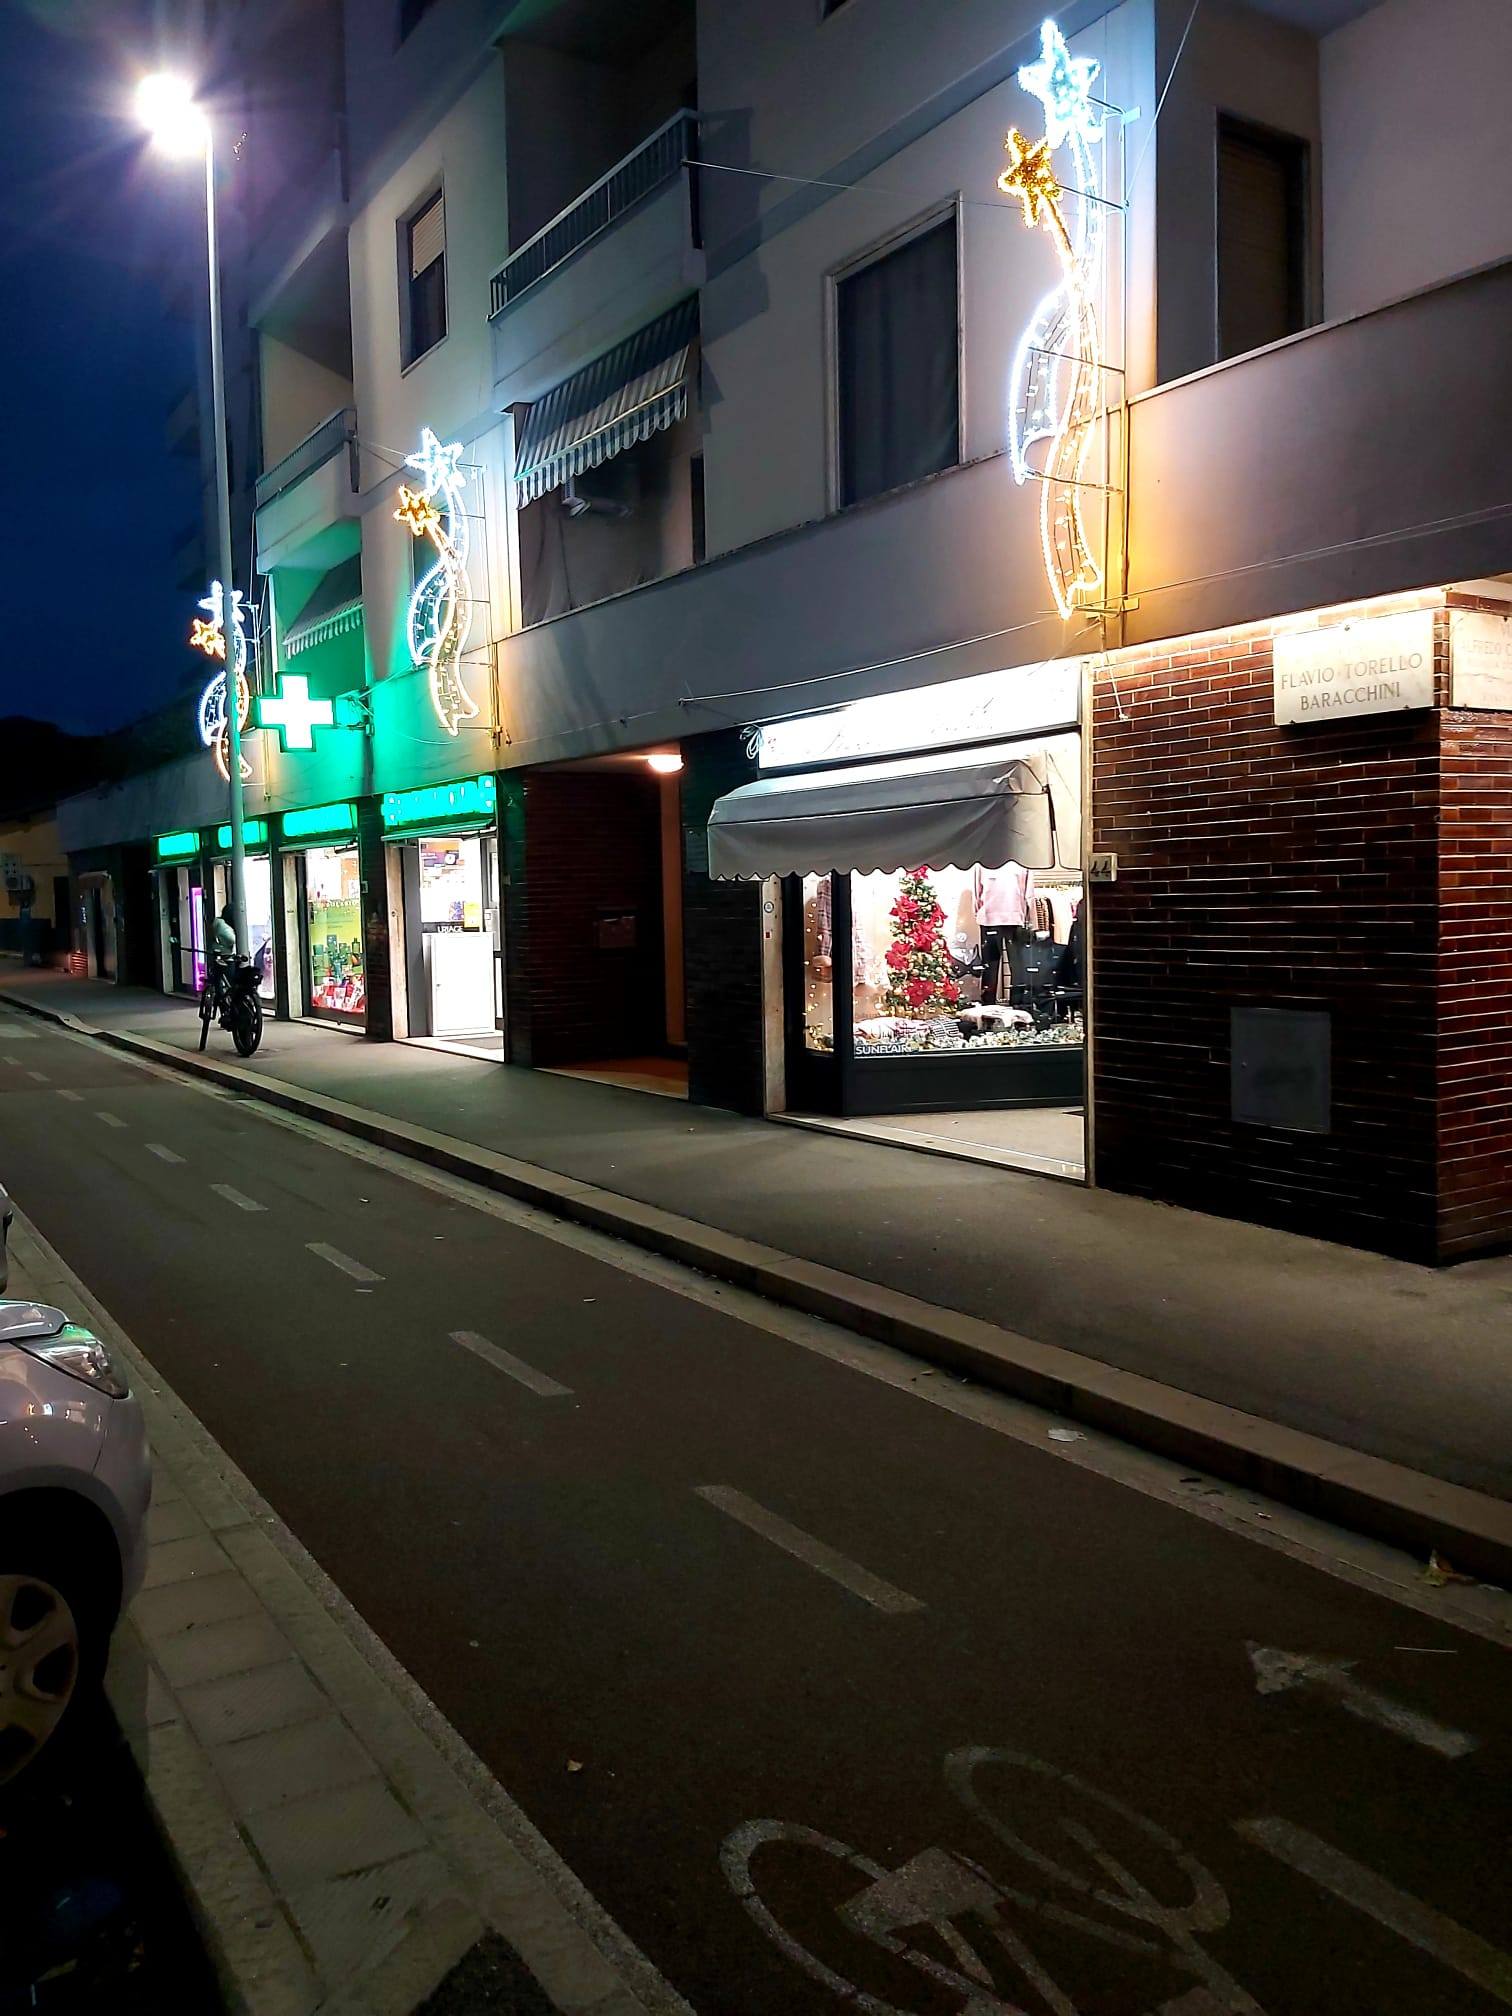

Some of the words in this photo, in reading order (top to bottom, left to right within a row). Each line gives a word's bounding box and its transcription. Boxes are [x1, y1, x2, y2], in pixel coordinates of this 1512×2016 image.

[1281, 667, 1335, 689] FLAVIO
[1344, 652, 1423, 679] TORELLO
[1300, 681, 1401, 711] BARACCHINI
